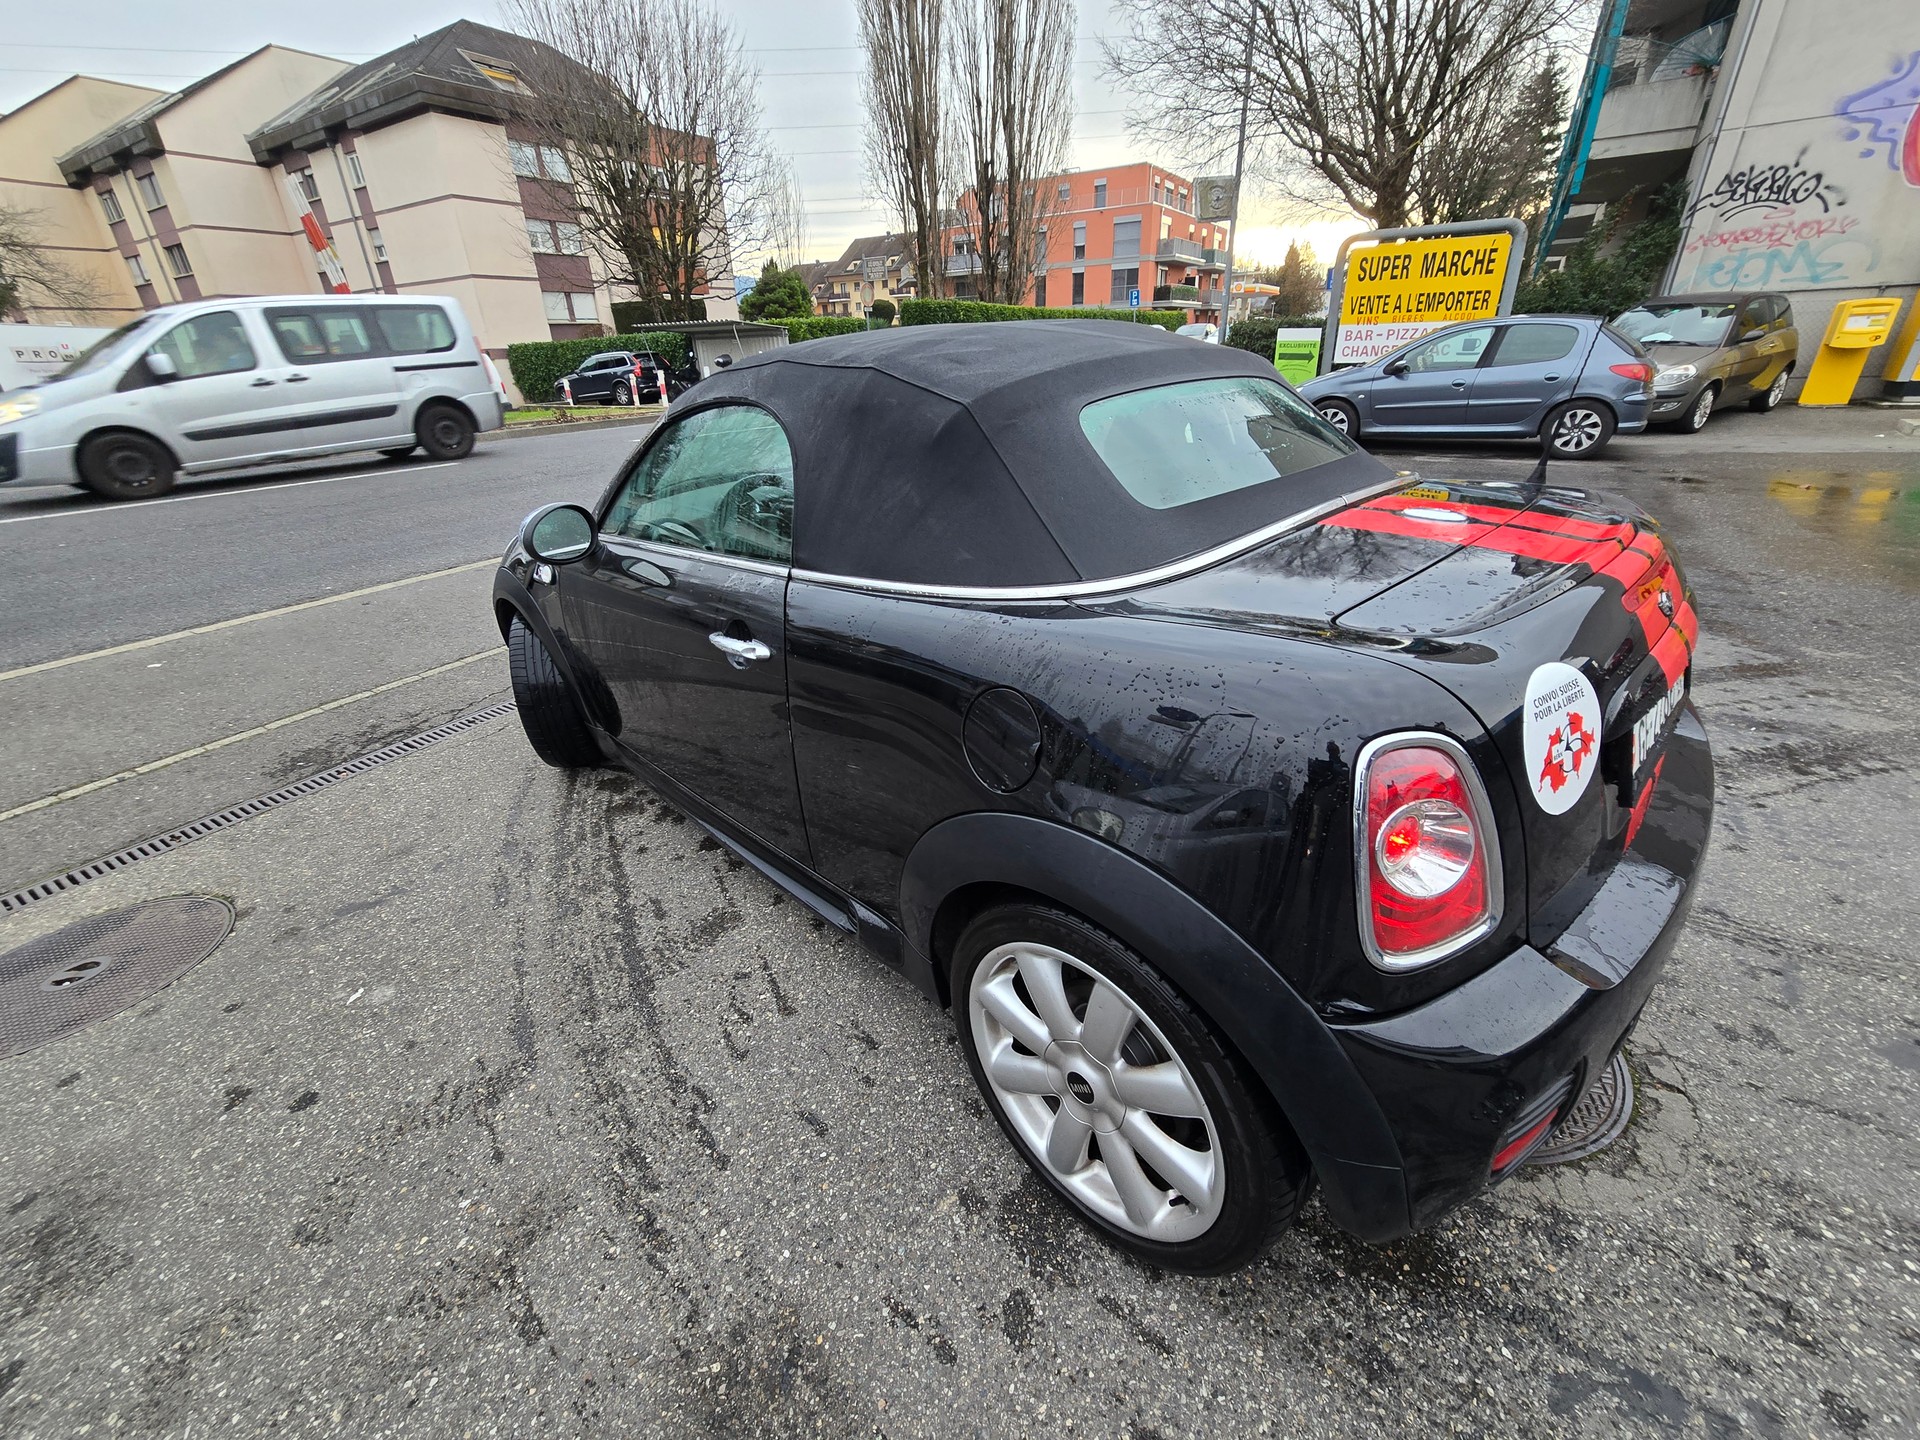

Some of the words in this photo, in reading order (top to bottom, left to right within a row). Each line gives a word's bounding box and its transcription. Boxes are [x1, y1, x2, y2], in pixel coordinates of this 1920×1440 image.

[1357, 254, 1413, 282] SUPER
[1419, 239, 1499, 279] MARCHÉ
[1350, 294, 1391, 316] VENTE
[1392, 293, 1402, 314] A
[1406, 289, 1492, 313] L'EMPORTER
[1356, 315, 1380, 326] VINS
[1391, 314, 1425, 323] BIERES
[1442, 312, 1477, 321] ALCOOL
[1344, 329, 1374, 341] BAR
[1279, 341, 1318, 349] EXCLUSIVITÉ
[1533, 689, 1560, 709] CONVOI
[1558, 678, 1580, 696] SUISSE
[1533, 705, 1554, 722] POUR
[1553, 701, 1563, 712] LA
[1070, 1083, 1092, 1094] MINI
